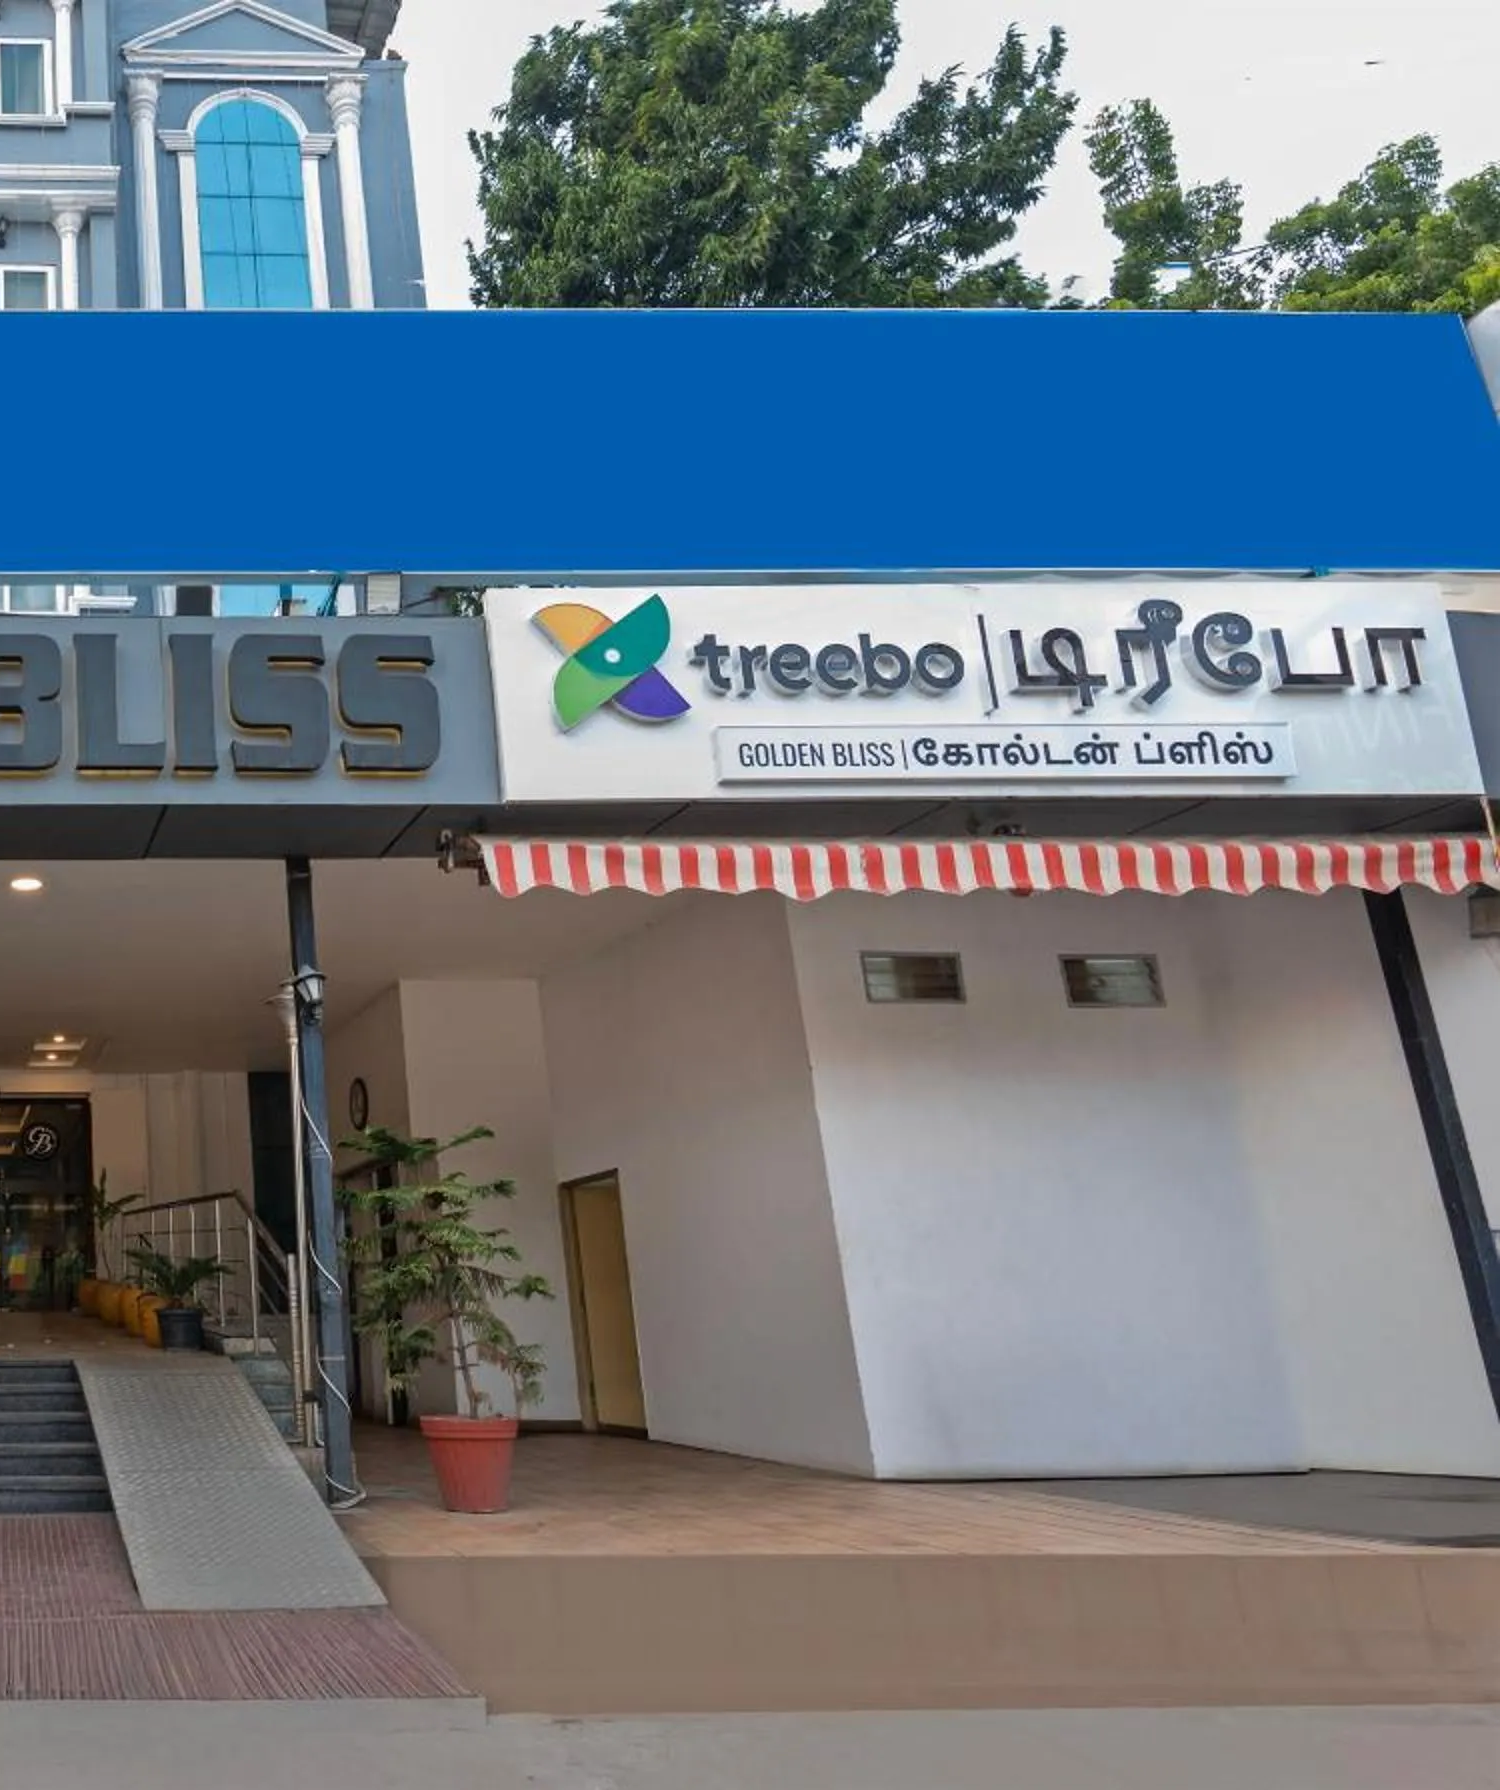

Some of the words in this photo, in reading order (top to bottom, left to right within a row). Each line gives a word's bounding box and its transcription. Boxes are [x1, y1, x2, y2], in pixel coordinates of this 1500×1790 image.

[690, 633, 966, 697] treebo
[1003, 598, 1426, 714] டிரீபோ
[738, 742, 825, 768] GOLDEN
[832, 741, 895, 767] BLISS
[912, 733, 1119, 767] கோல்டன்
[1134, 731, 1273, 766] ப்ளிஸ்
